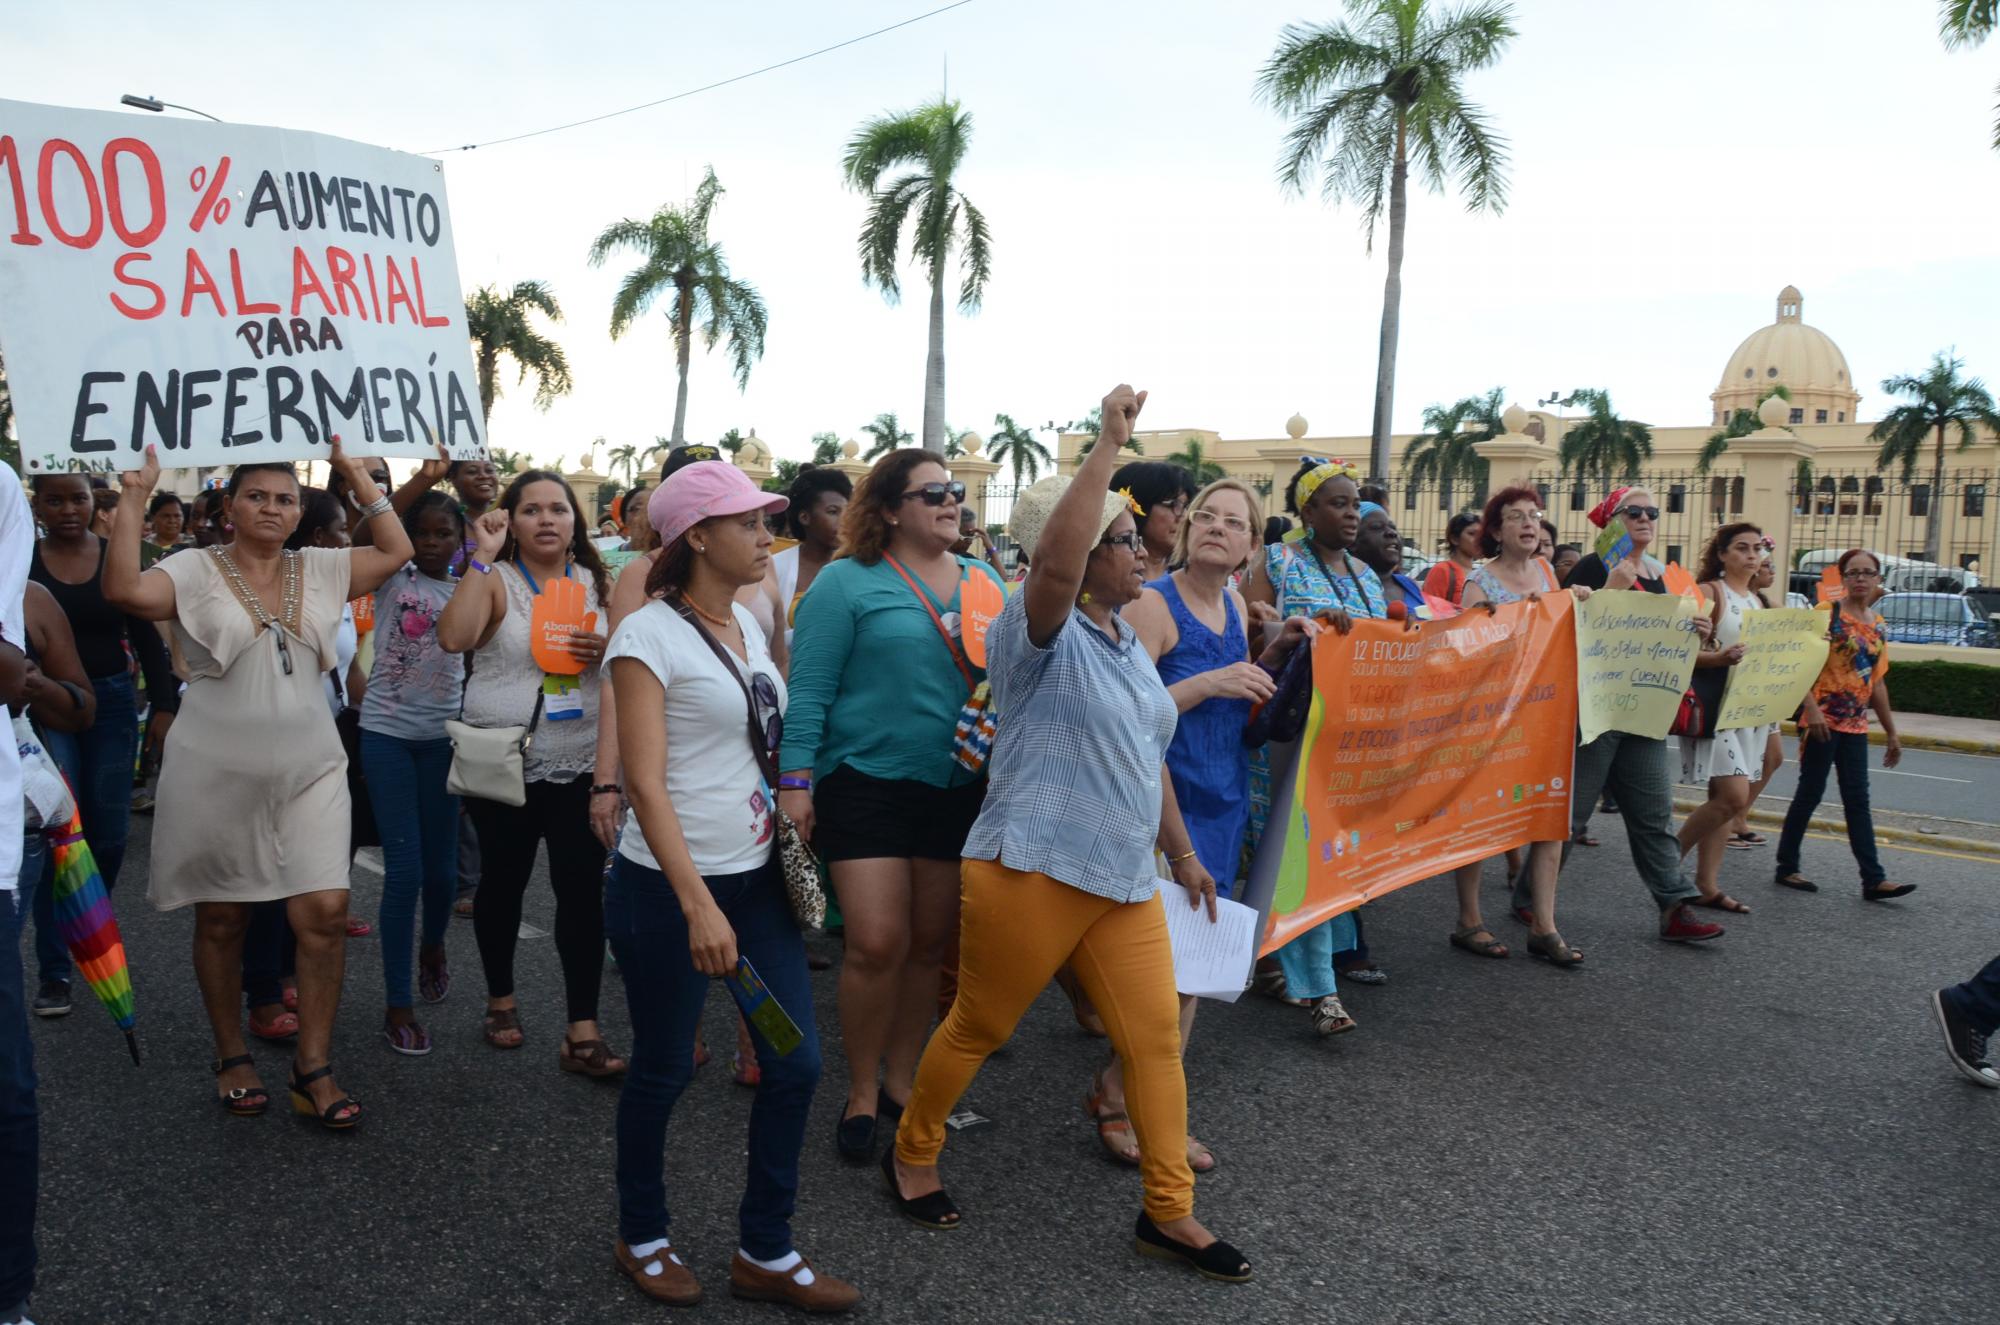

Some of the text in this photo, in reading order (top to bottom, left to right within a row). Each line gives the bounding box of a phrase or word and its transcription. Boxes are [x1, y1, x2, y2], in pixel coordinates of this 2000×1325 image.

[0, 134, 441, 249] 100 % AUMENTO
[110, 246, 450, 328] SALARIAL
[236, 317, 343, 359] PARA
[70, 352, 480, 452] ENFERMERÍA
[1352, 640, 1368, 660] 12
